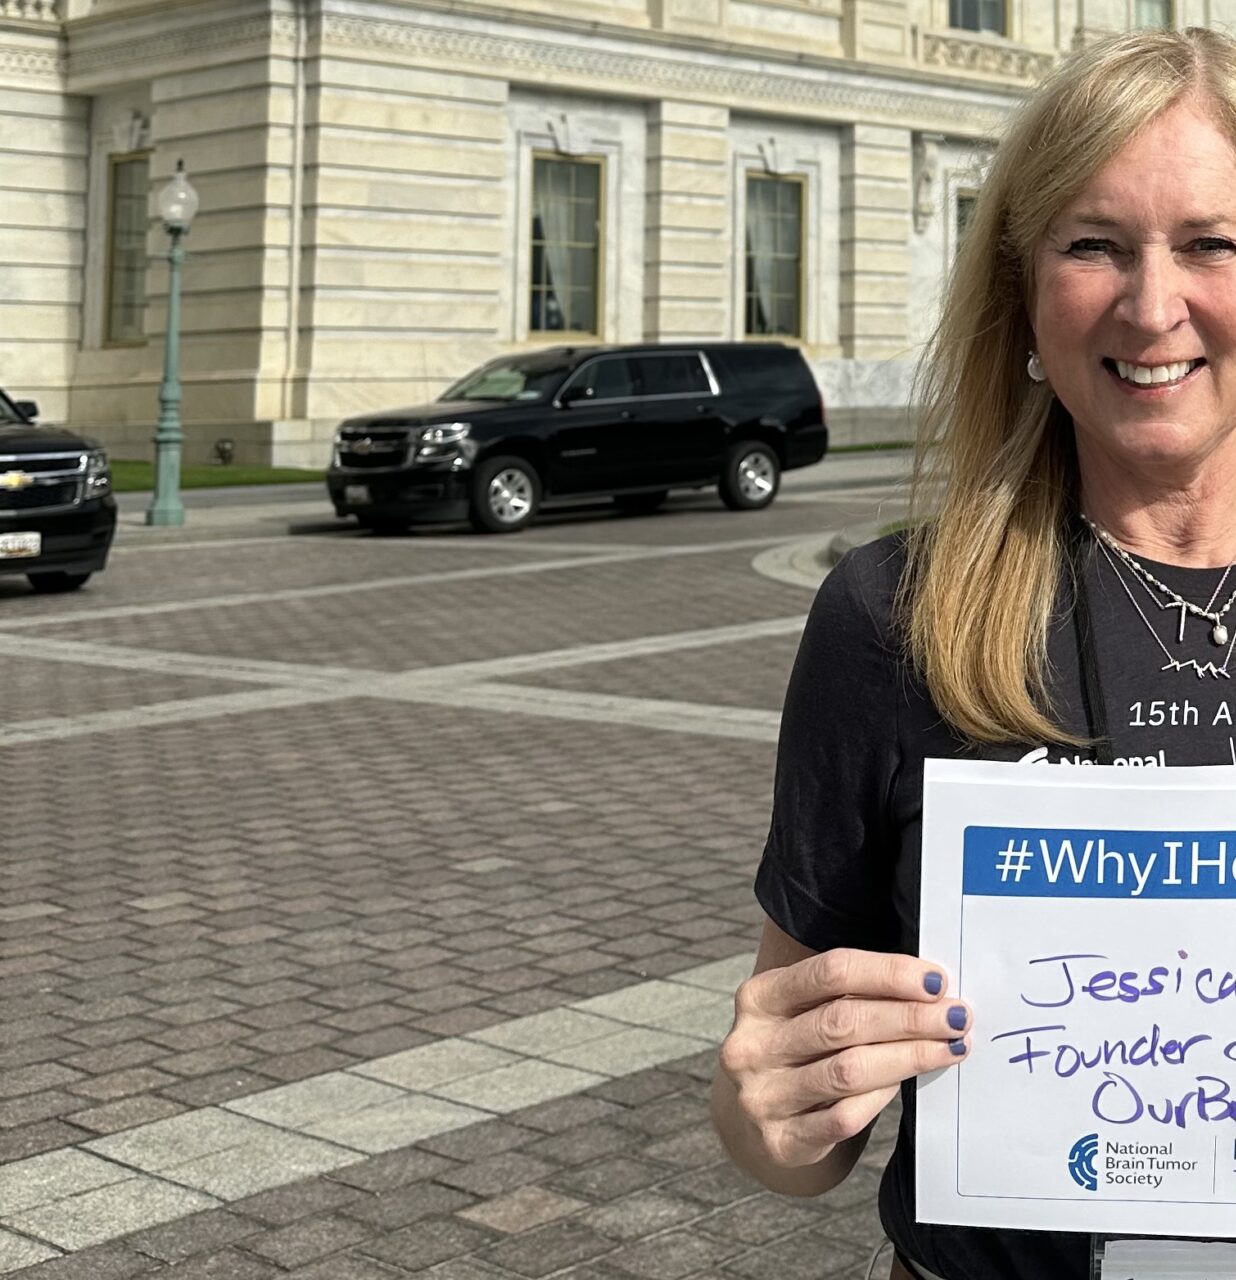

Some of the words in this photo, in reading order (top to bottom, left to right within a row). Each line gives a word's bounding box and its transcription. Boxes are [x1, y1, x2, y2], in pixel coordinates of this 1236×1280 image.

[1129, 699, 1199, 726] 15th
[990, 1025, 1213, 1078] Founder
[1105, 1141, 1173, 1155] National
[1105, 1156, 1145, 1170] Brain
[1147, 1157, 1198, 1171] Tumor
[1105, 1172, 1163, 1188] Society
